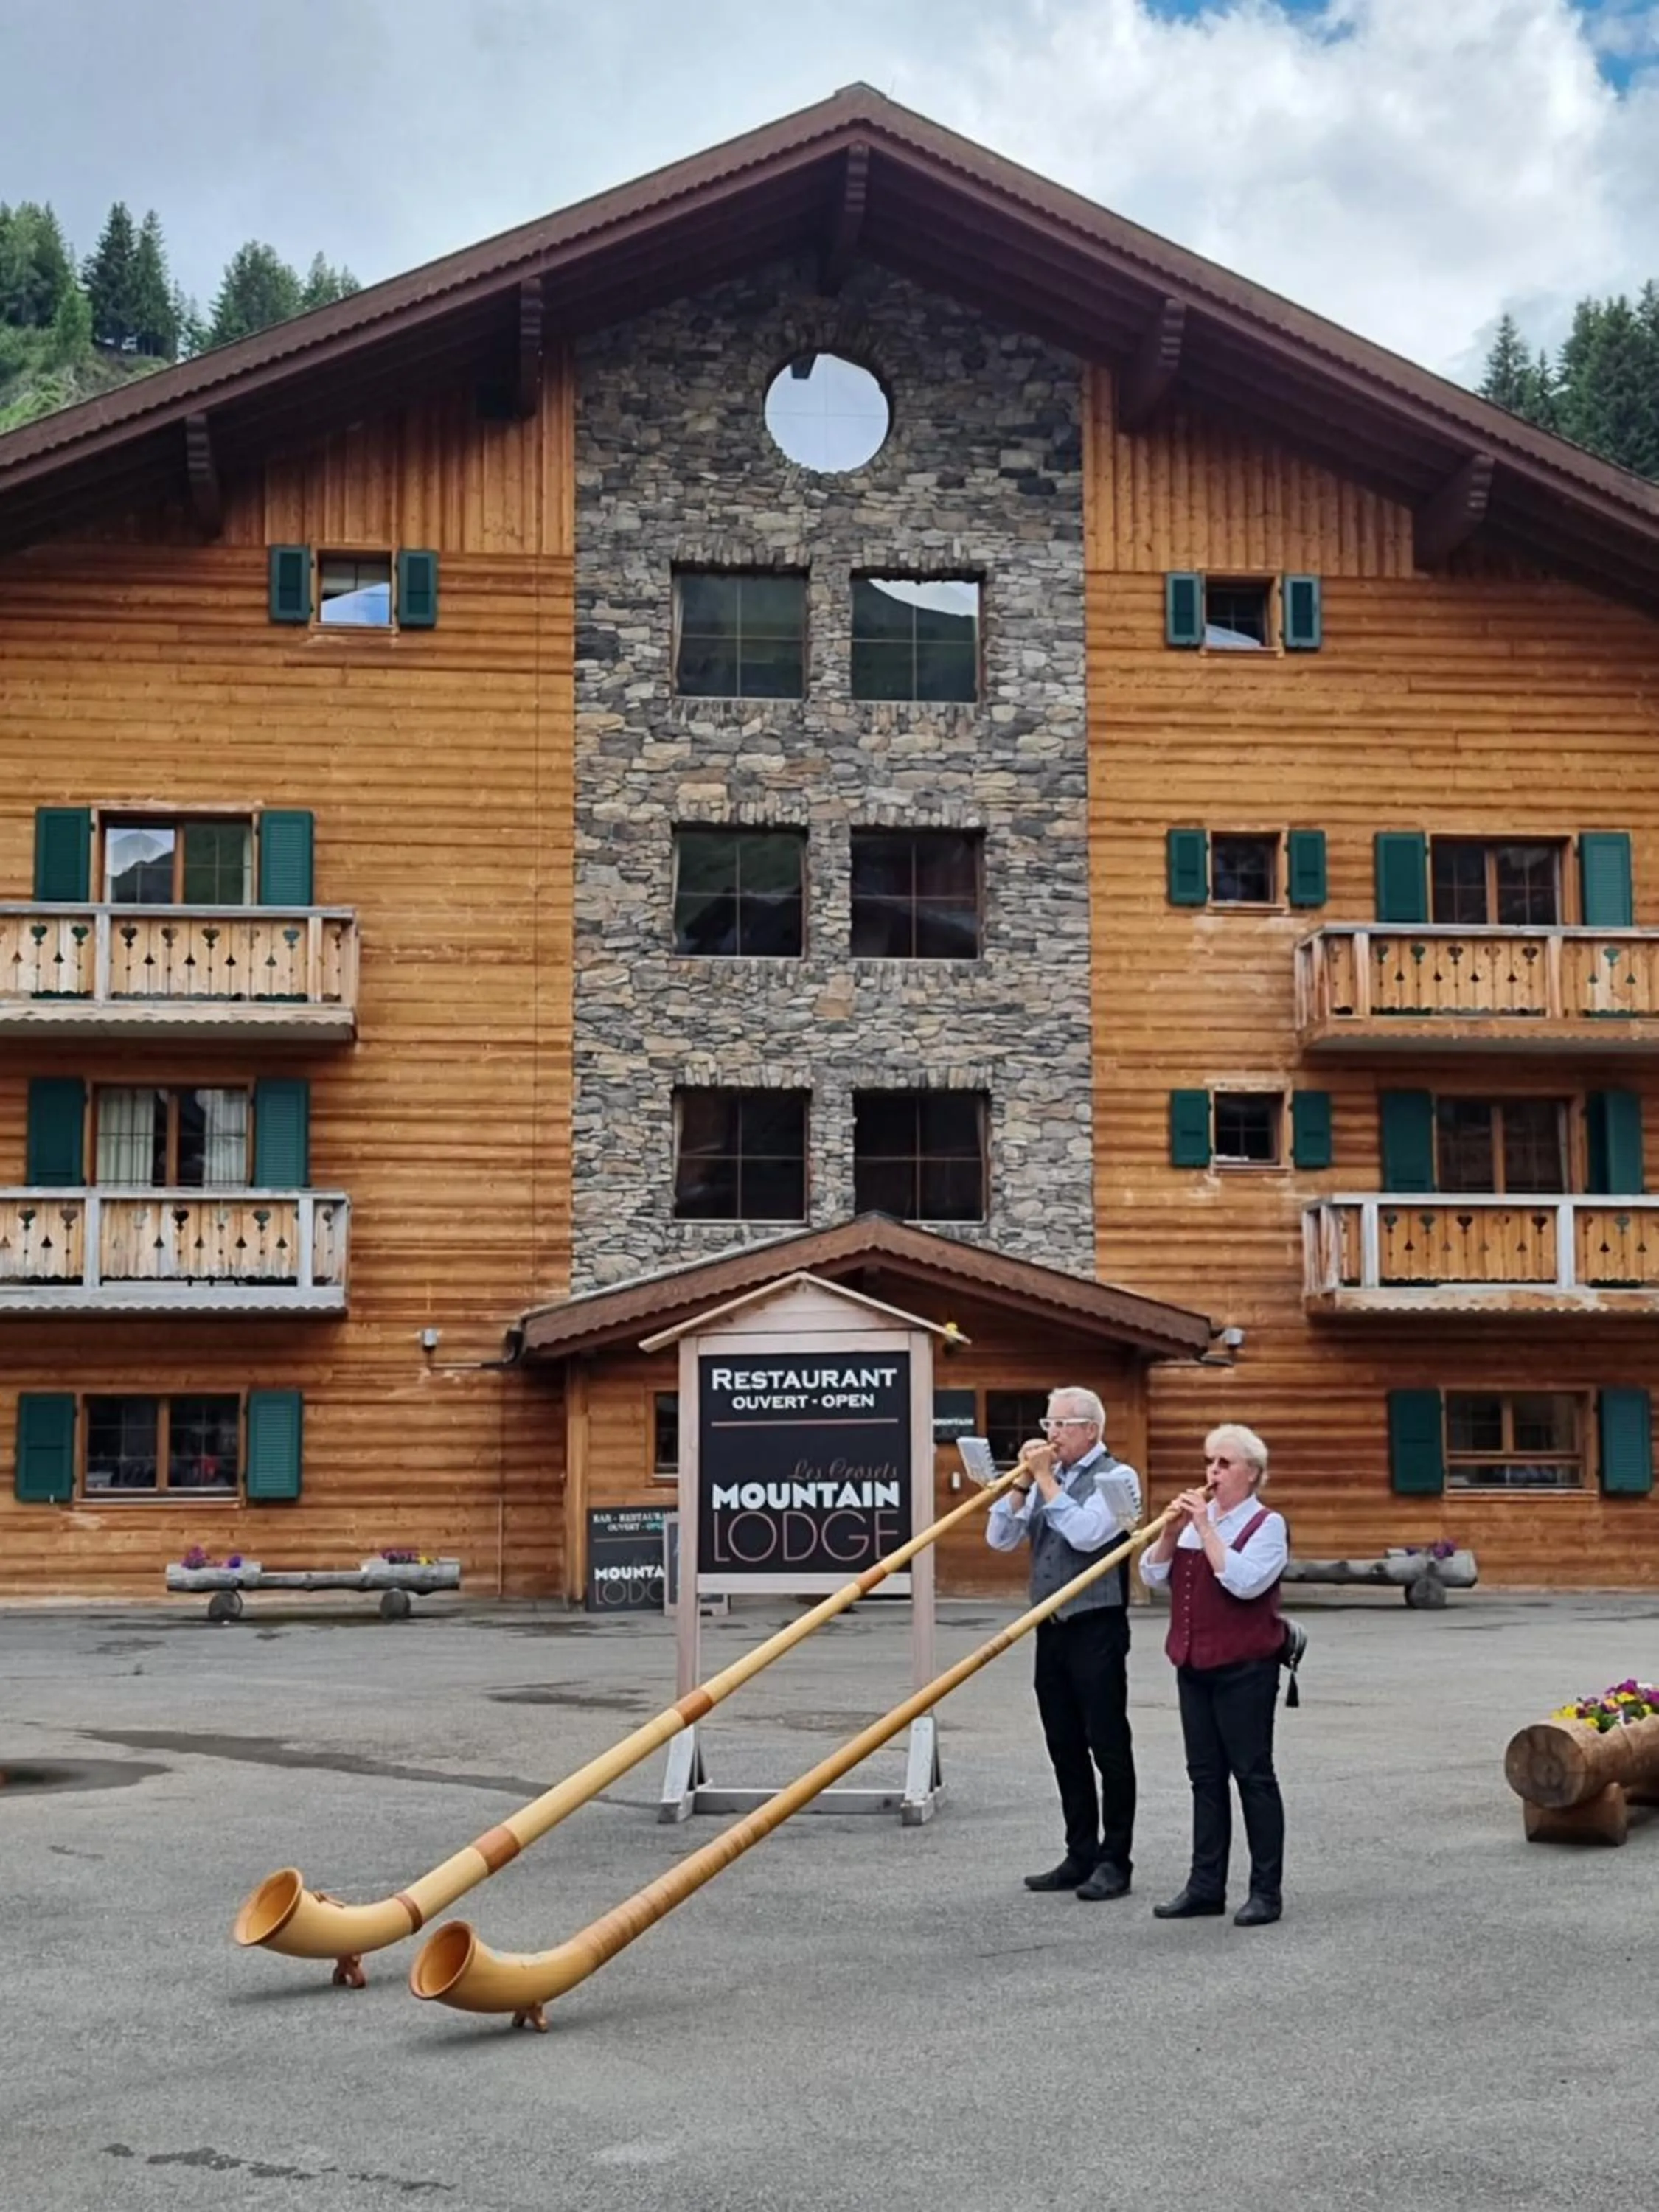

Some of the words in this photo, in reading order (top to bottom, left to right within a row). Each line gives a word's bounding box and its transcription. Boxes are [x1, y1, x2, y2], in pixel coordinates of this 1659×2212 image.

[711, 1368, 897, 1391] RESTAURANT
[731, 1395, 809, 1410] OUVERT
[821, 1393, 875, 1408] OPEN
[787, 1458, 821, 1481] Les
[829, 1457, 897, 1481] Crosets
[712, 1481, 900, 1510] MOUNTAIN
[714, 1510, 899, 1563] LODGE
[594, 1565, 665, 1581] MOUNTA
